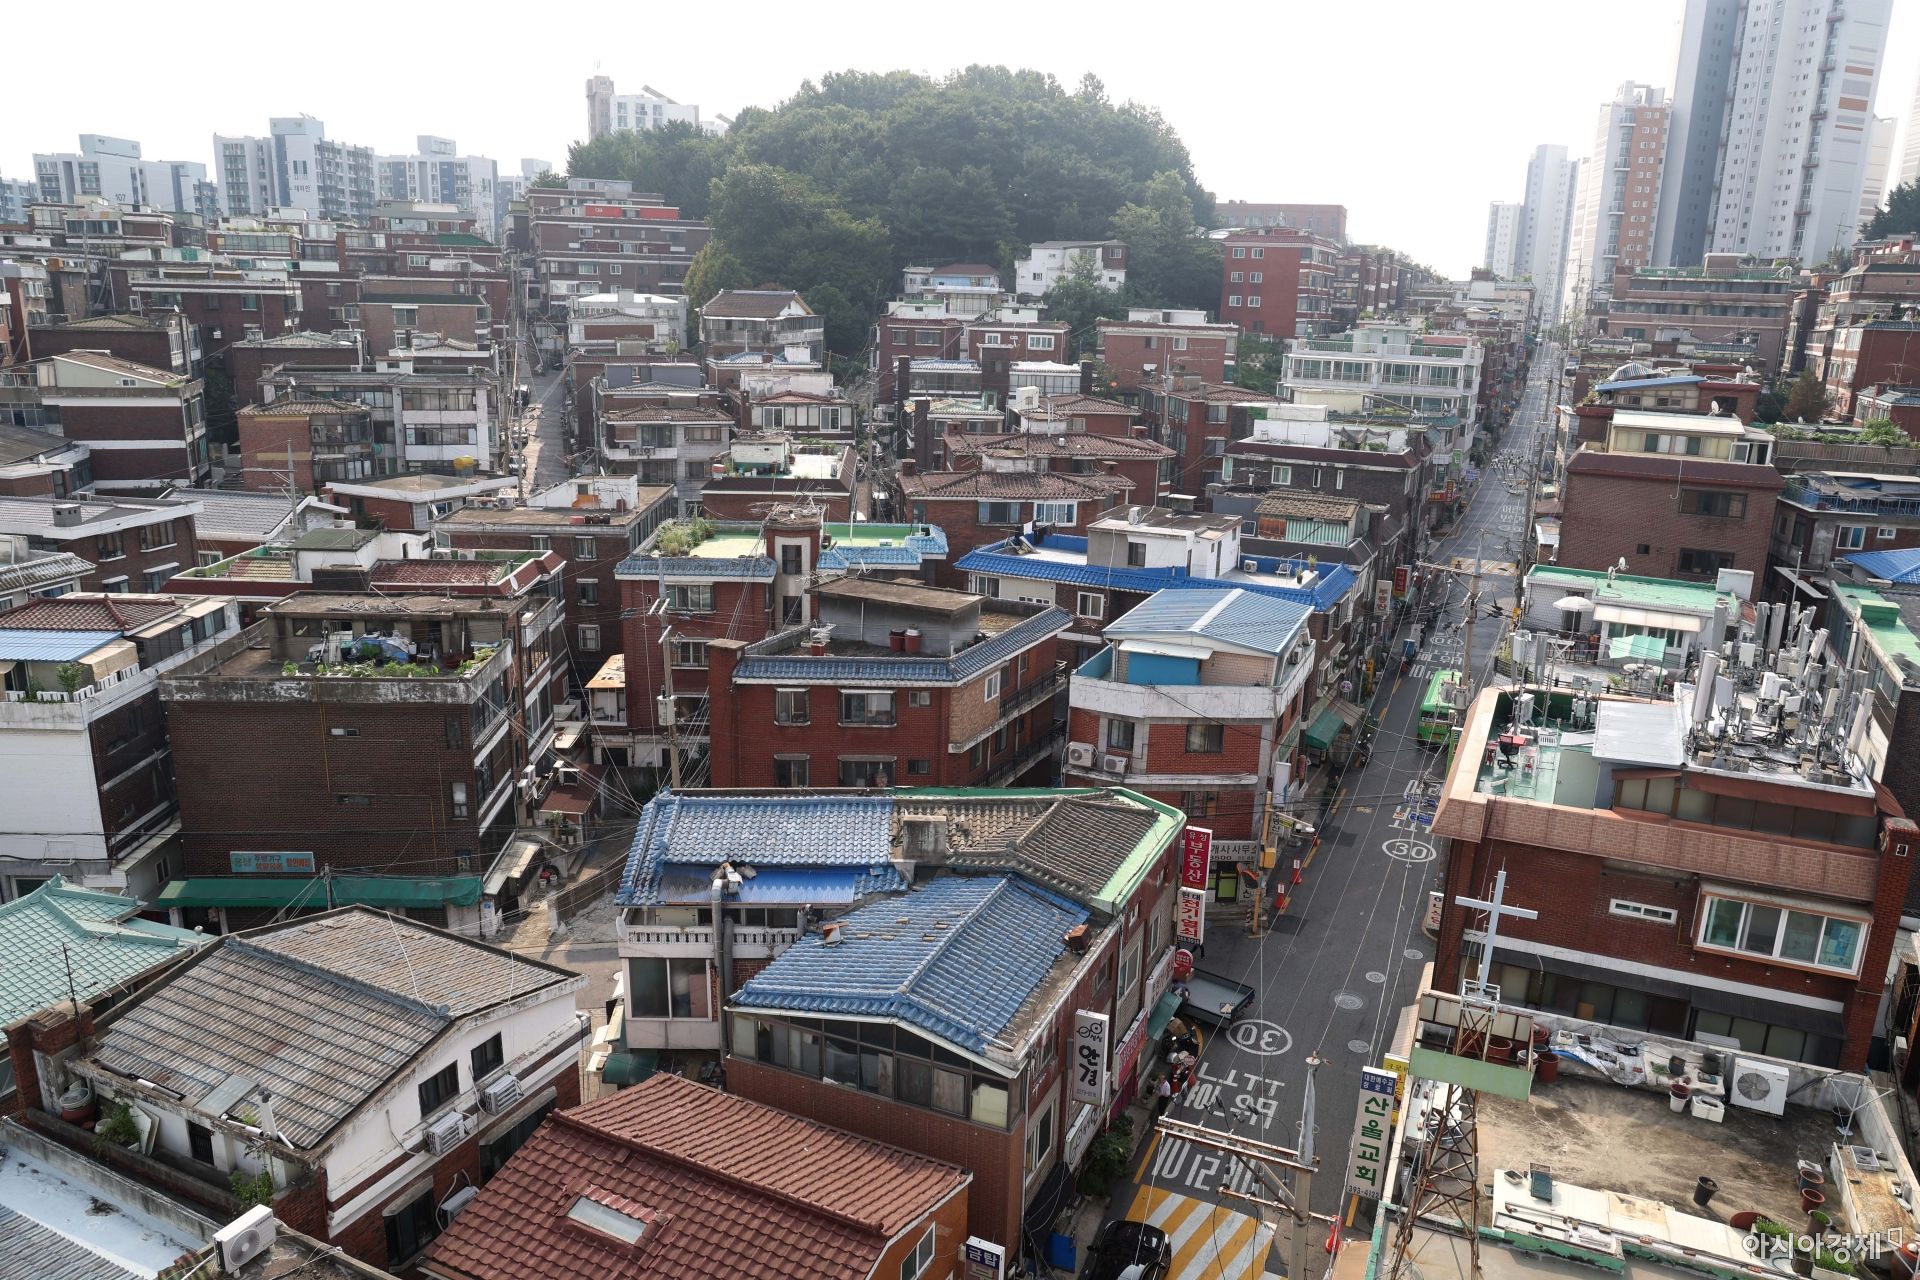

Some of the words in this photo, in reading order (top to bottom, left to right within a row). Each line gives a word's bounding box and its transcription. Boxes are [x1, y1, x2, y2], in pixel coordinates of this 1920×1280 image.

[1186, 841, 1205, 882] 부동산
[1391, 842, 1428, 859] 30
[1236, 1023, 1282, 1051] 30
[1078, 1044, 1101, 1087] 안경
[1355, 1096, 1390, 1187] 산울교회
[1348, 1185, 1380, 1199] 393-4122
[968, 1246, 998, 1268] 금탑
